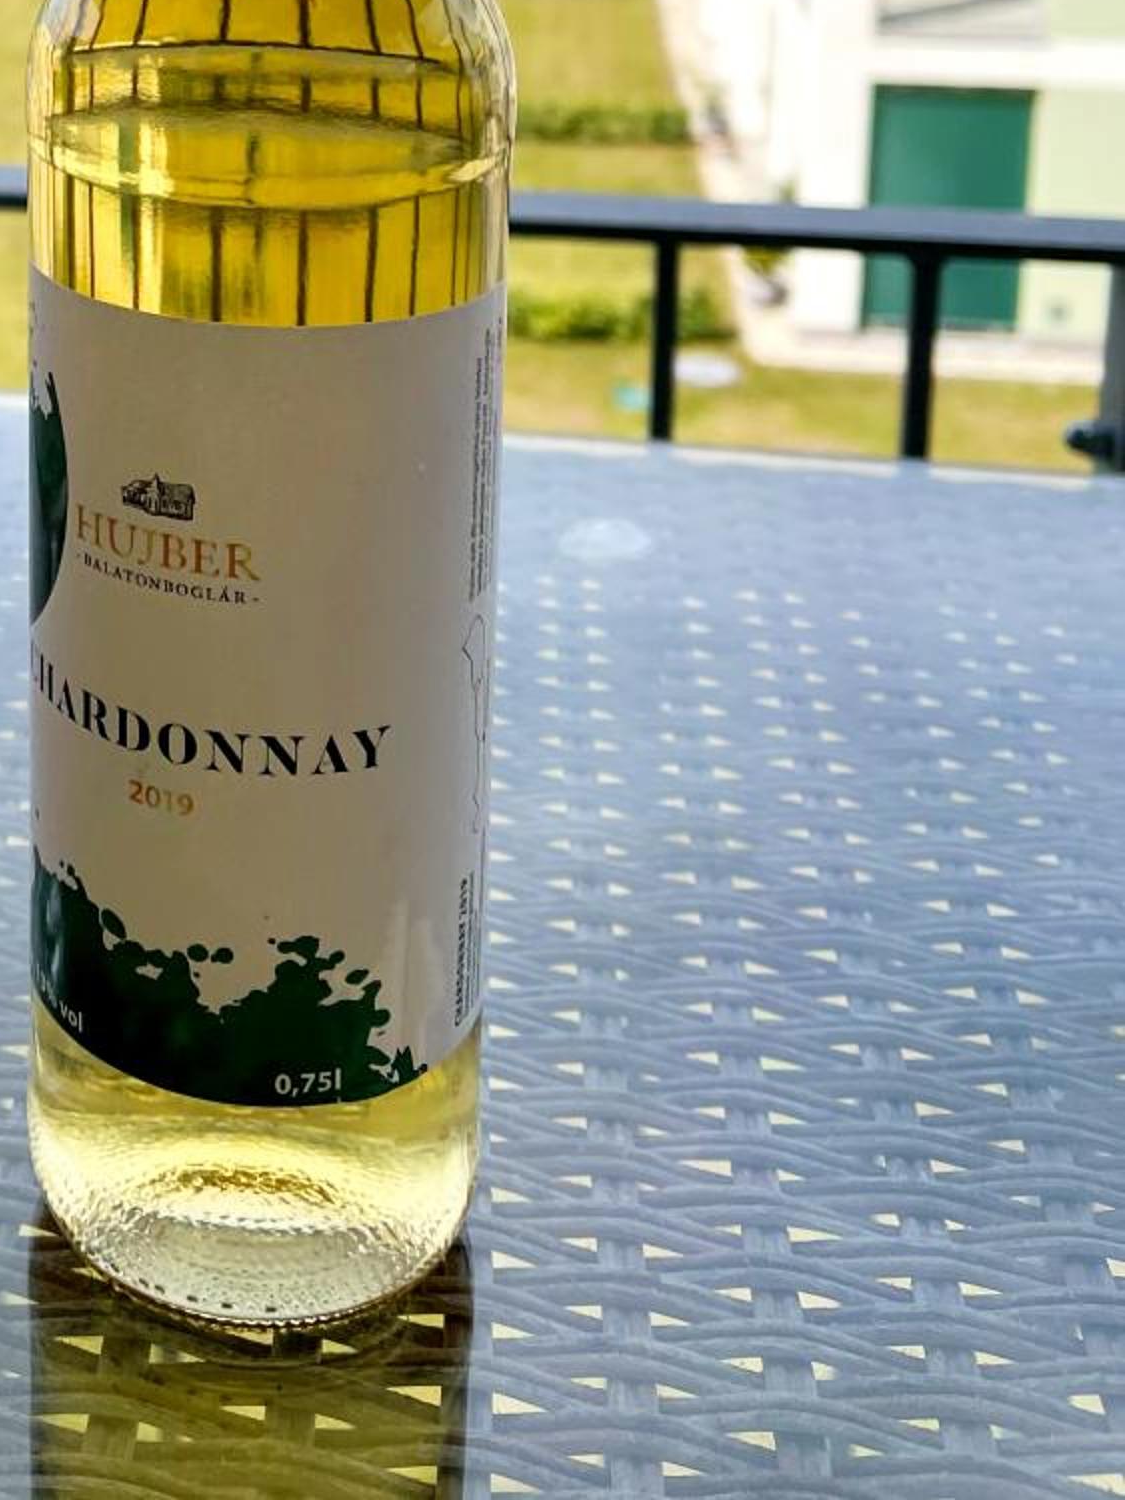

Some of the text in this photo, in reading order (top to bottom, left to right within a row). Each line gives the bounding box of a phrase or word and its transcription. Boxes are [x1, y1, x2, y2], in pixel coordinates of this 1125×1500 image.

[76, 503, 262, 582] HUJBER
[83, 553, 247, 604] BALATONBOGLÁR
[128, 779, 195, 817] 2019
[59, 999, 83, 1034] vol
